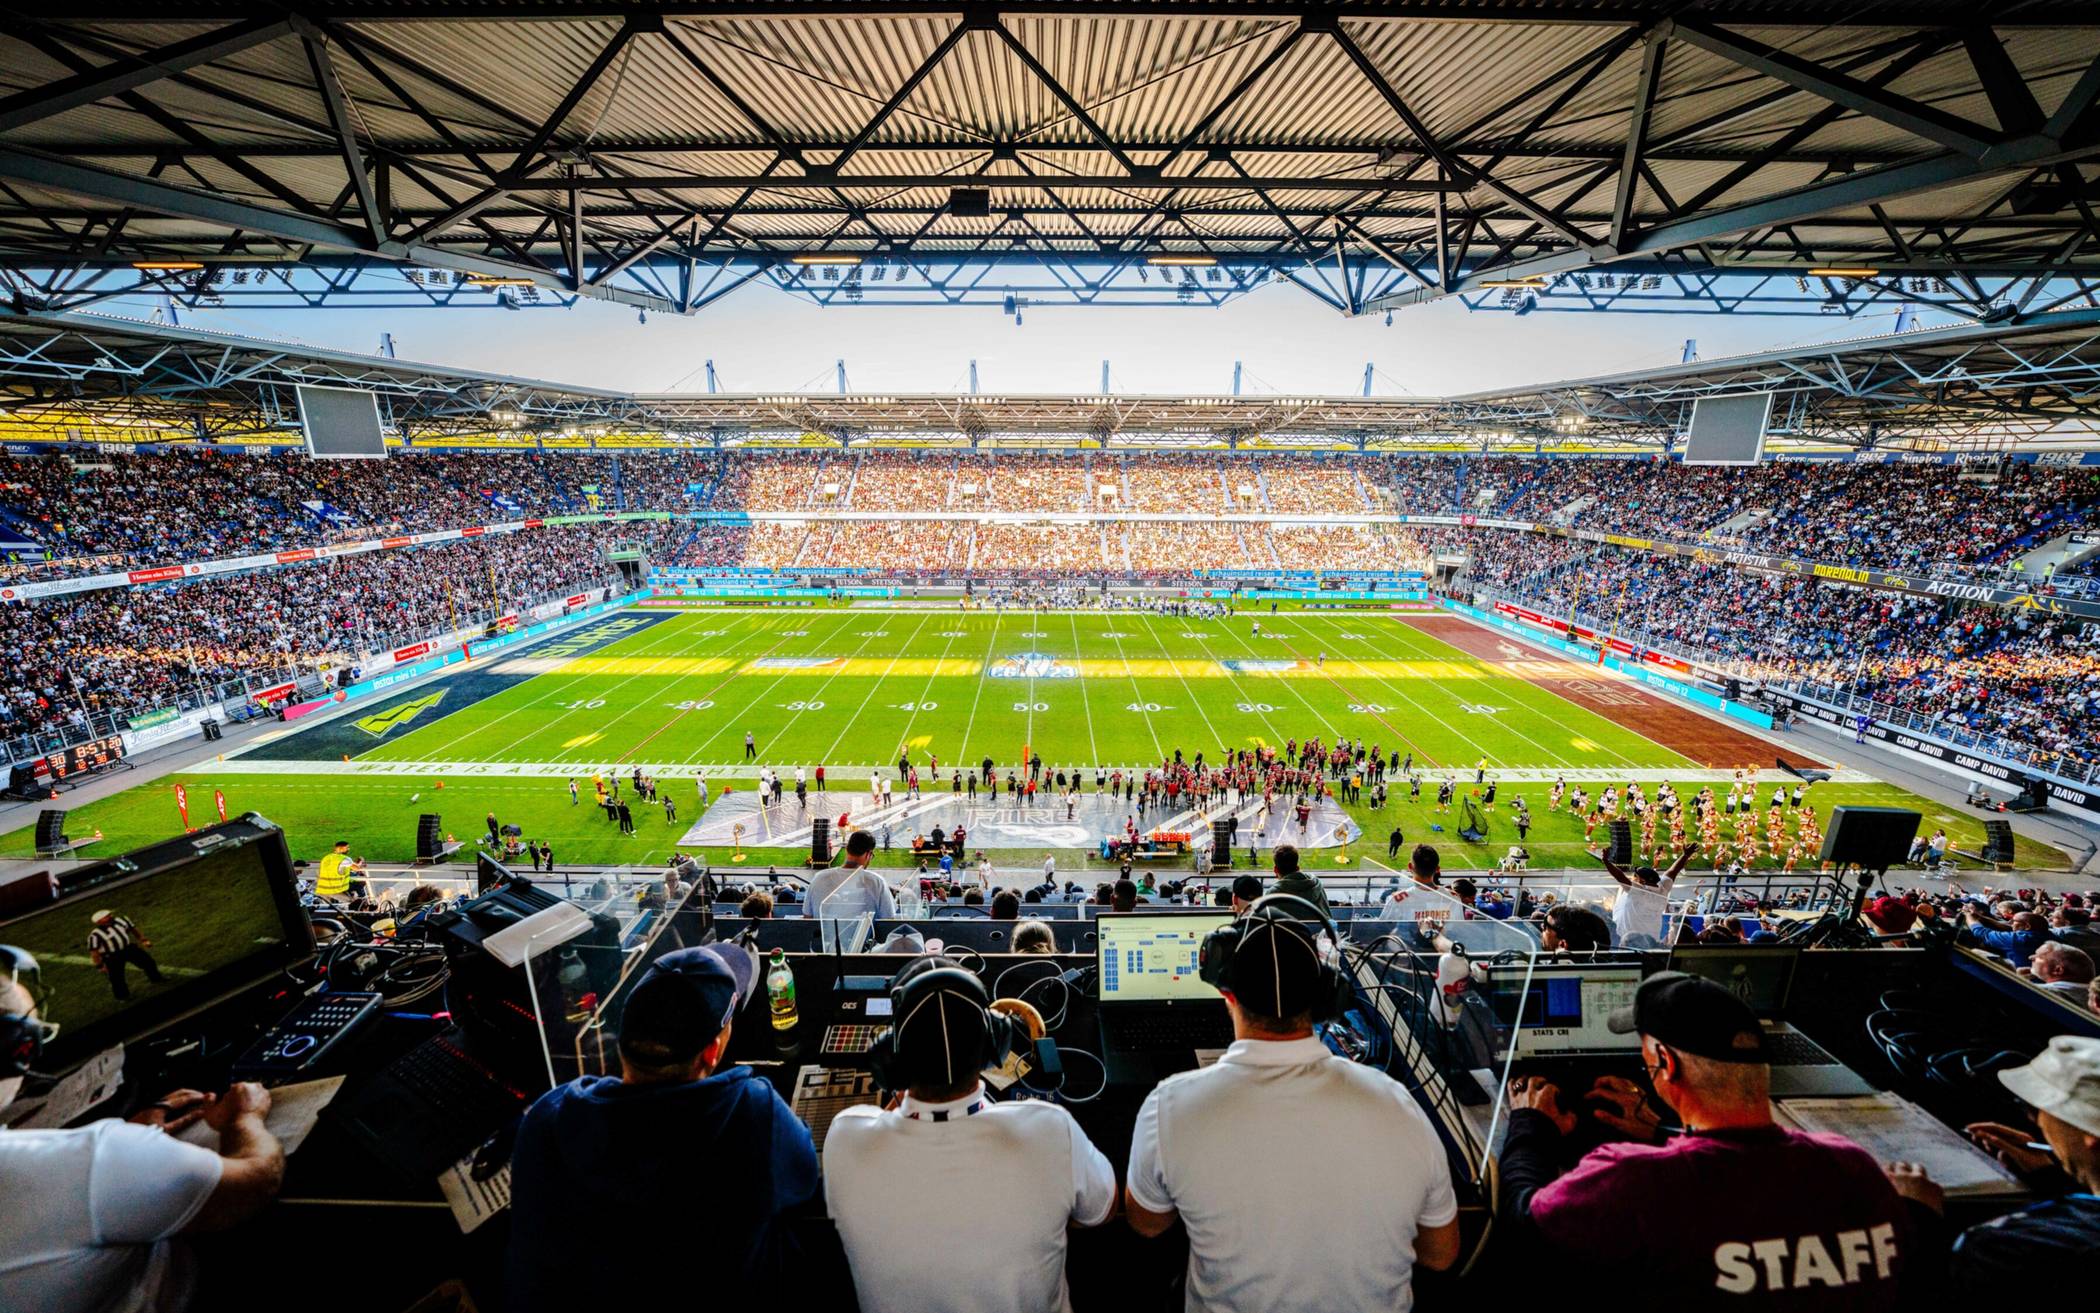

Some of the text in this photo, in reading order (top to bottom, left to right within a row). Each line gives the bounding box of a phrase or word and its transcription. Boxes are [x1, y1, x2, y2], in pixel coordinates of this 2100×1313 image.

[1900, 453, 1942, 464] Sinalco
[1724, 552, 1770, 568] ARTISTIK
[132, 571, 151, 582] Heute
[163, 568, 183, 579] König
[1813, 564, 1870, 583] ADRENALIN
[1926, 581, 1995, 601] ACTION
[373, 667, 417, 690] instax mini 12
[1647, 672, 1689, 697] instax mini 12
[565, 700, 606, 710] 10
[675, 700, 715, 710] 20
[787, 701, 825, 711] 30
[900, 701, 938, 711] 40
[1013, 702, 1049, 712] 50
[1126, 702, 1161, 712] 40
[1236, 703, 1274, 713] 30
[1347, 703, 1386, 713] 20
[1458, 704, 1496, 714] 10
[1800, 704, 1837, 723] CAMP DAVID
[75, 740, 107, 758] 8:57
[108, 738, 122, 749] 20
[1897, 735, 1943, 758] CAMP DAVID
[355, 764, 453, 773] WATER
[464, 765, 488, 774] IS
[539, 766, 636, 776] HUMAN
[656, 767, 748, 777] RIGHT
[1518, 770, 1626, 779] RACISM
[1955, 754, 2009, 780] CAMP DAVID
[176, 788, 187, 811] KFC
[2053, 785, 2086, 806] DAVID
[216, 794, 226, 817] KFC
[966, 808, 1082, 831] FIRE
[1715, 1222, 1897, 1295] STAFF
